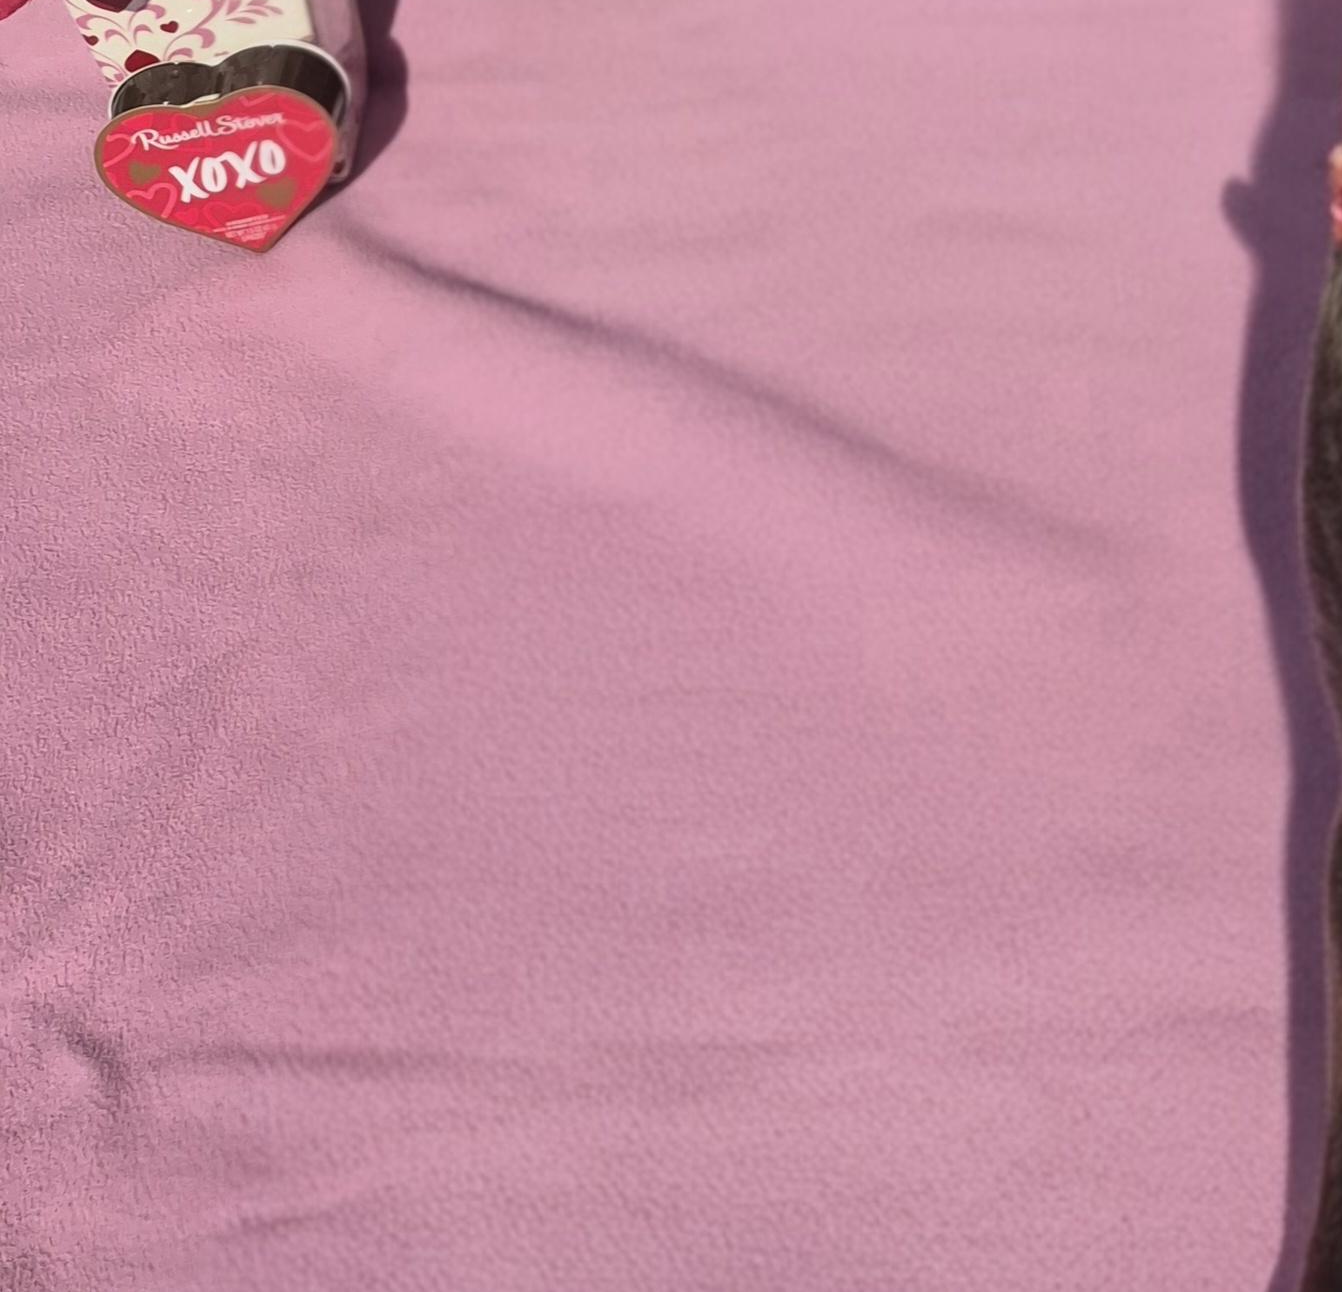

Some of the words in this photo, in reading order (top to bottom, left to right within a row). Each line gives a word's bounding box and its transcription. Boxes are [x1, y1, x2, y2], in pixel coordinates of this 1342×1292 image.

[130, 119, 217, 151] Russell
[216, 113, 287, 135] Stover
[168, 139, 286, 203] XOXO
